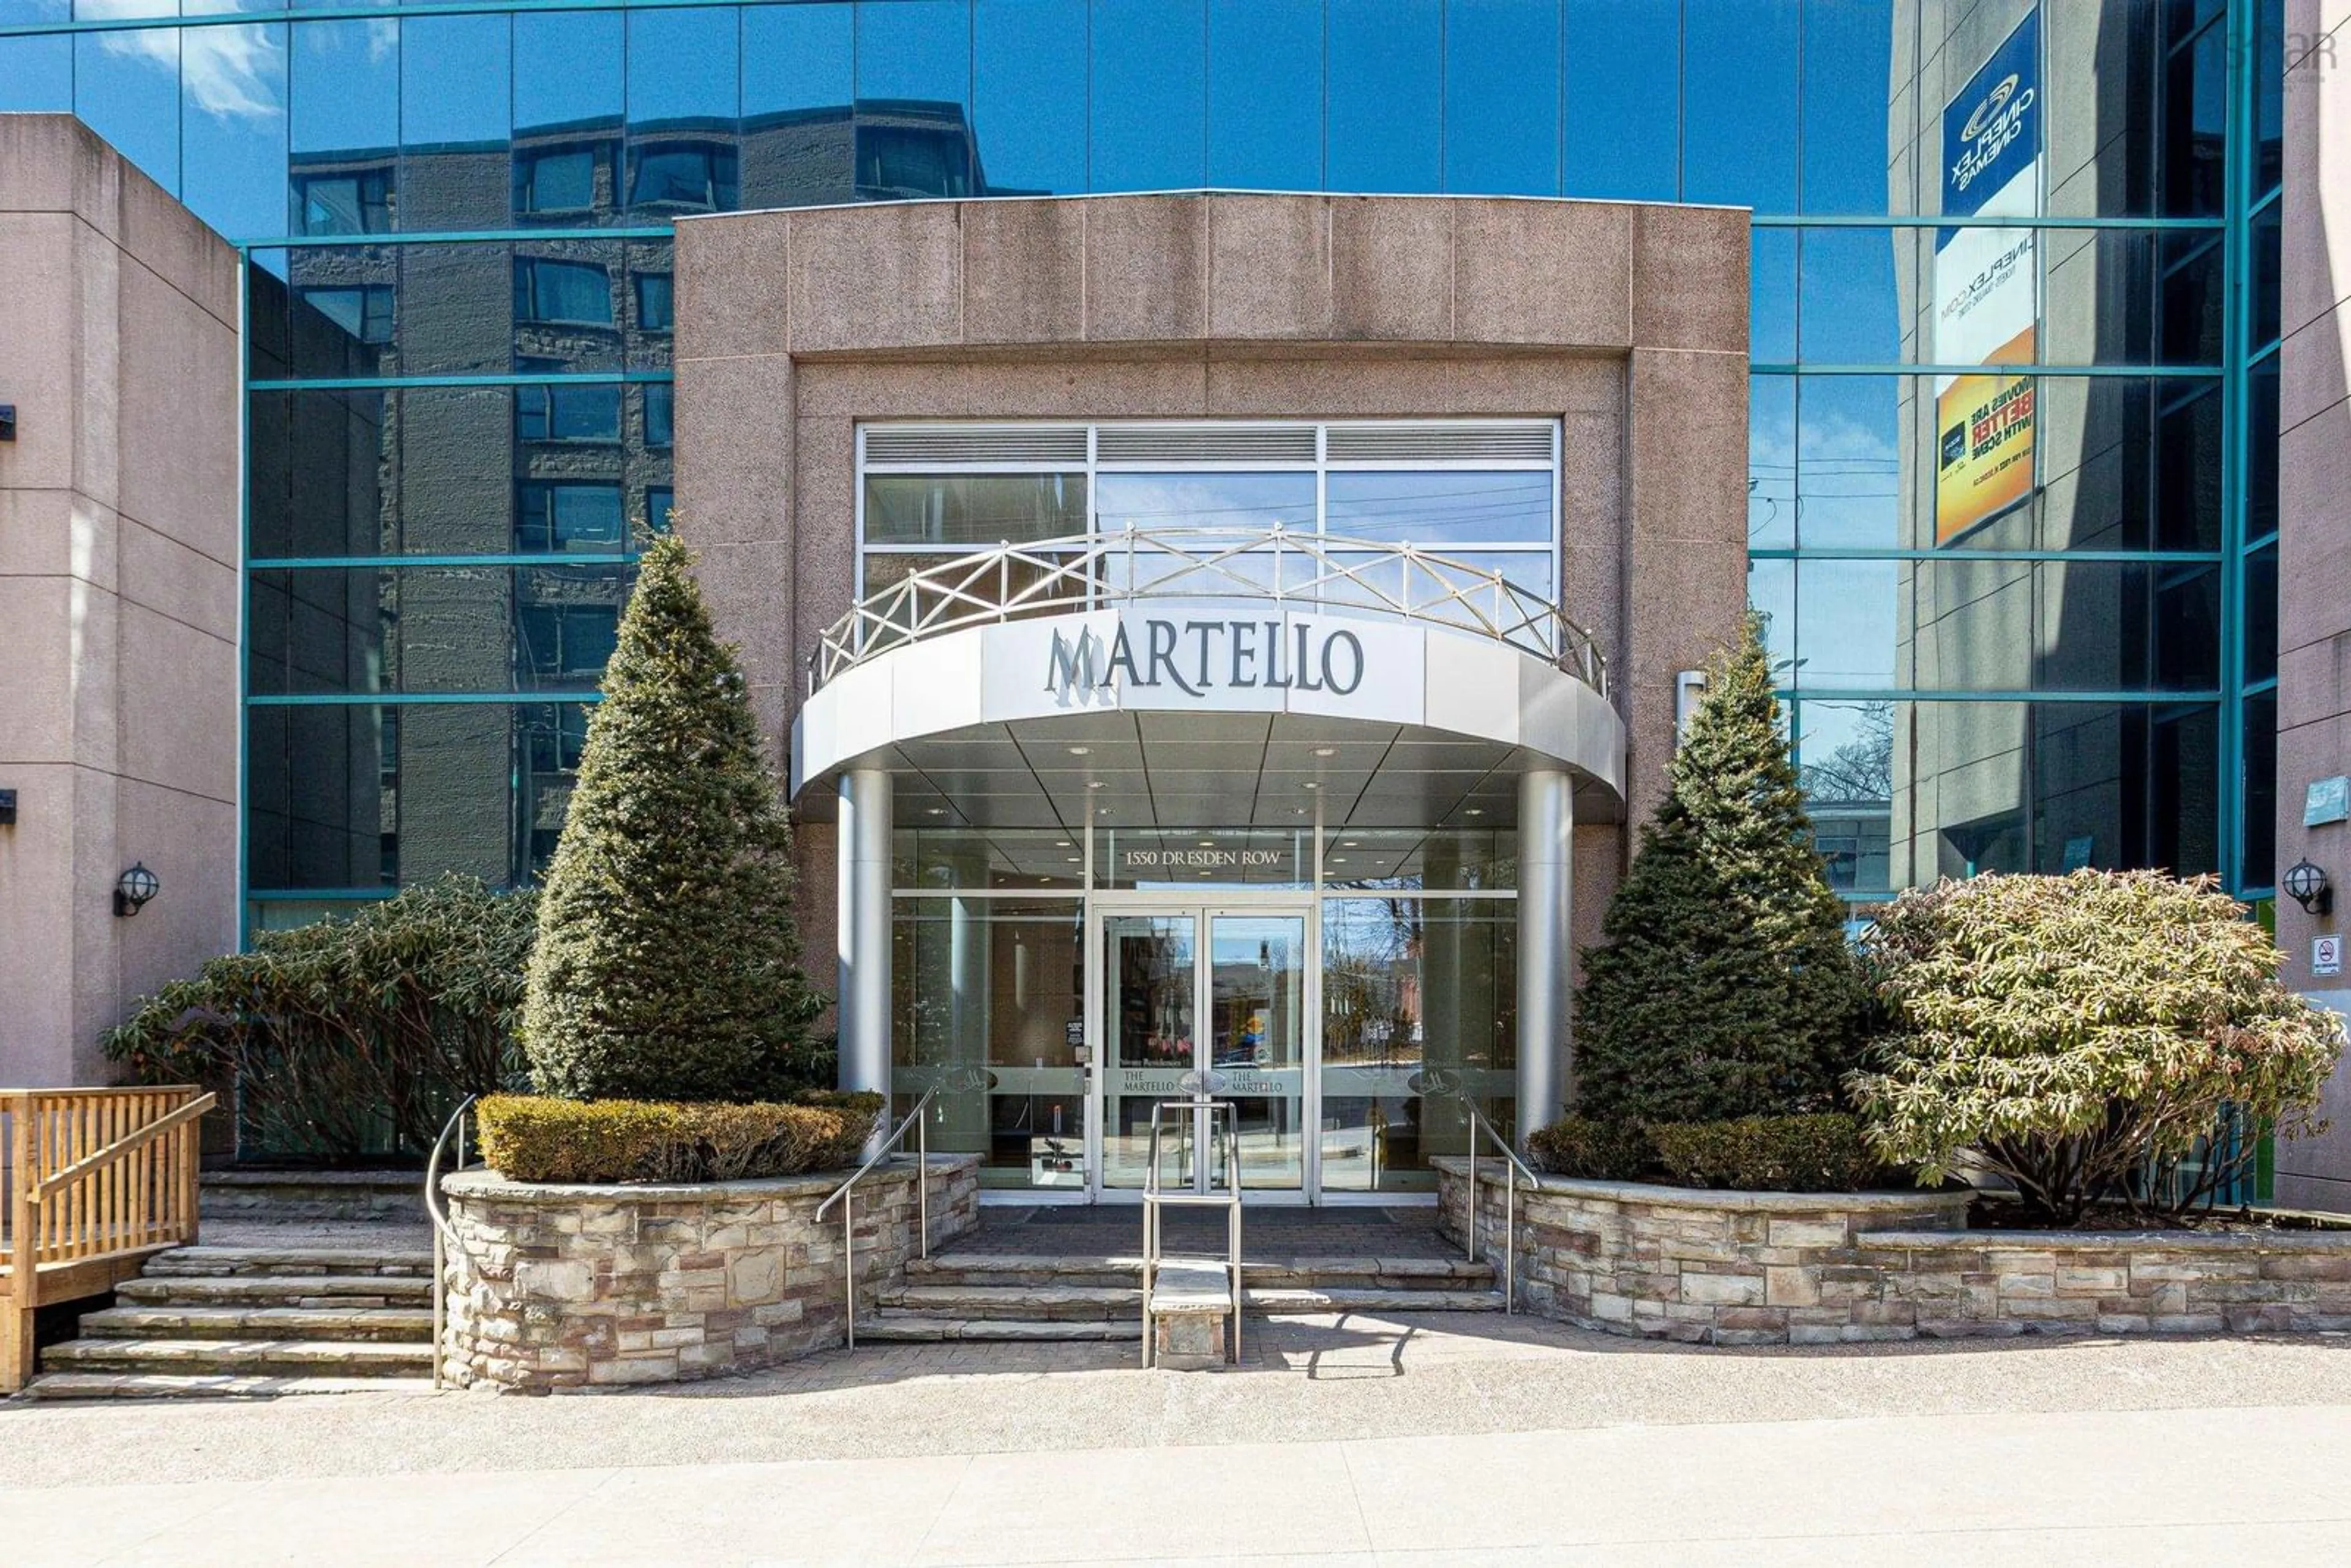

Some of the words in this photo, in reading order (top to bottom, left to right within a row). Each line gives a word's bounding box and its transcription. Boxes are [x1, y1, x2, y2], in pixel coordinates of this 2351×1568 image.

[1044, 620, 1364, 697] MARTELLO
[1127, 852, 1157, 865] 1550
[1163, 852, 1236, 865] DRESDEN
[1242, 851, 1281, 865] ROW
[1124, 1071, 1144, 1081] THE
[1232, 1071, 1251, 1081] THE
[1123, 1081, 1174, 1092] MARTELLO
[1232, 1082, 1282, 1093] MARTELLO
